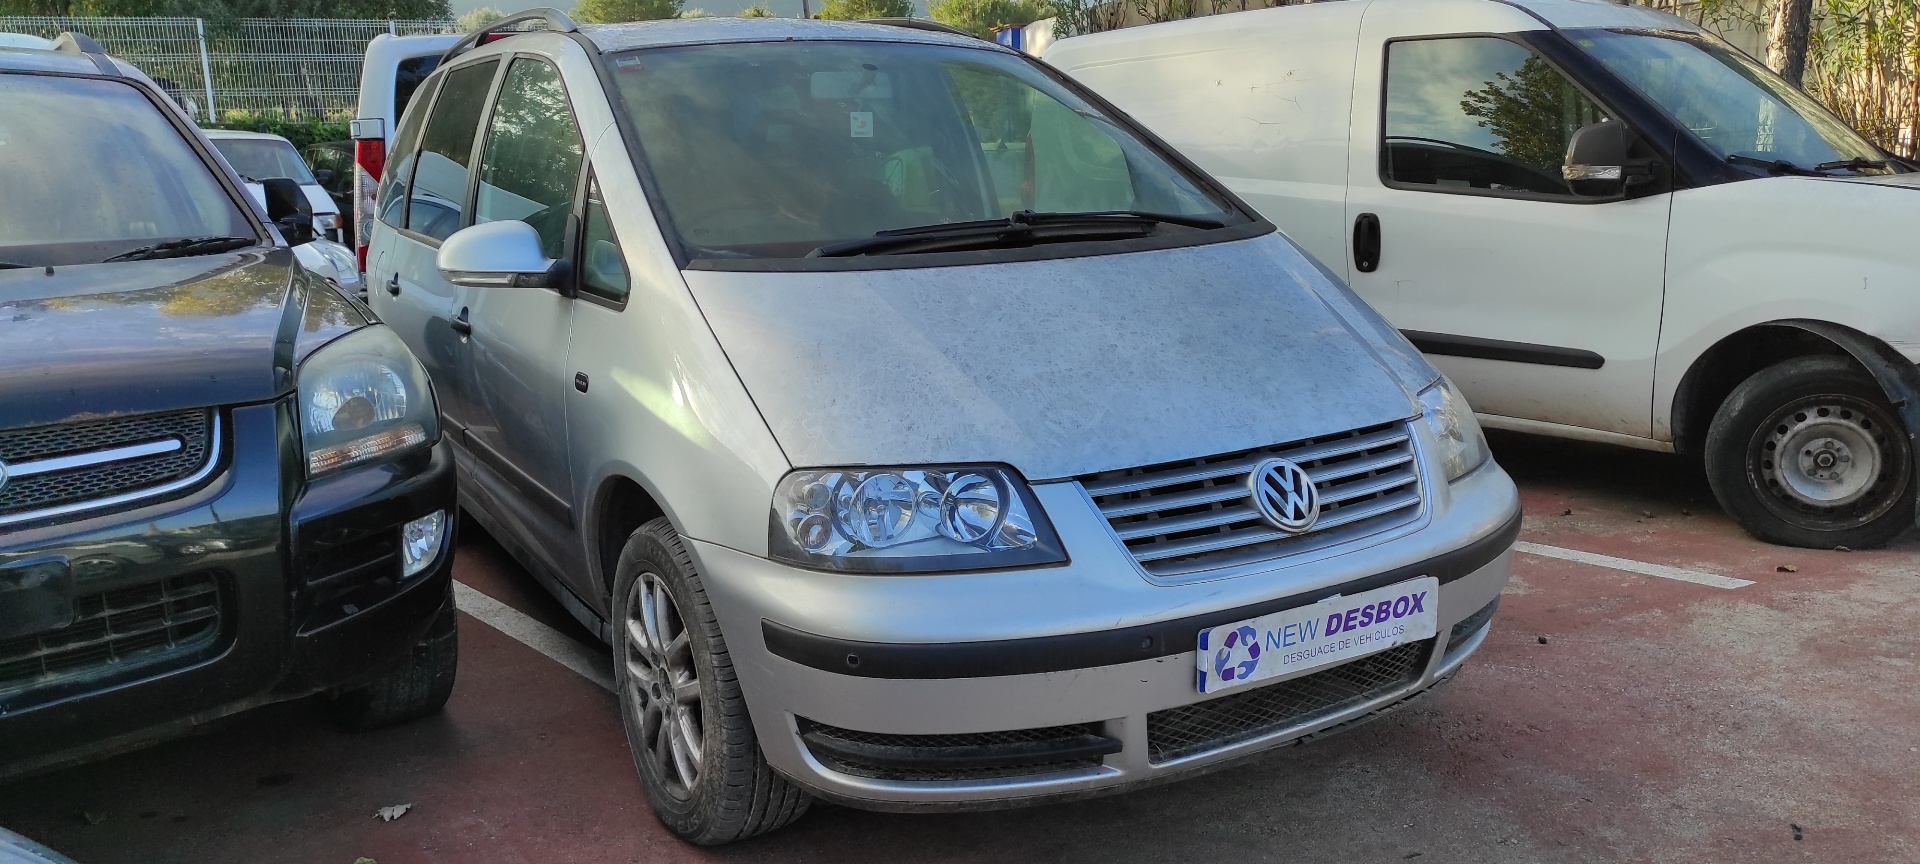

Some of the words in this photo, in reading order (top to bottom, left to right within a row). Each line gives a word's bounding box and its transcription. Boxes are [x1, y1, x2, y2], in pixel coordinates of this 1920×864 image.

[1265, 618, 1320, 652] NEW
[1324, 591, 1428, 637] DESBOX
[1283, 642, 1336, 665] DESGUACE
[1338, 638, 1351, 651] DE
